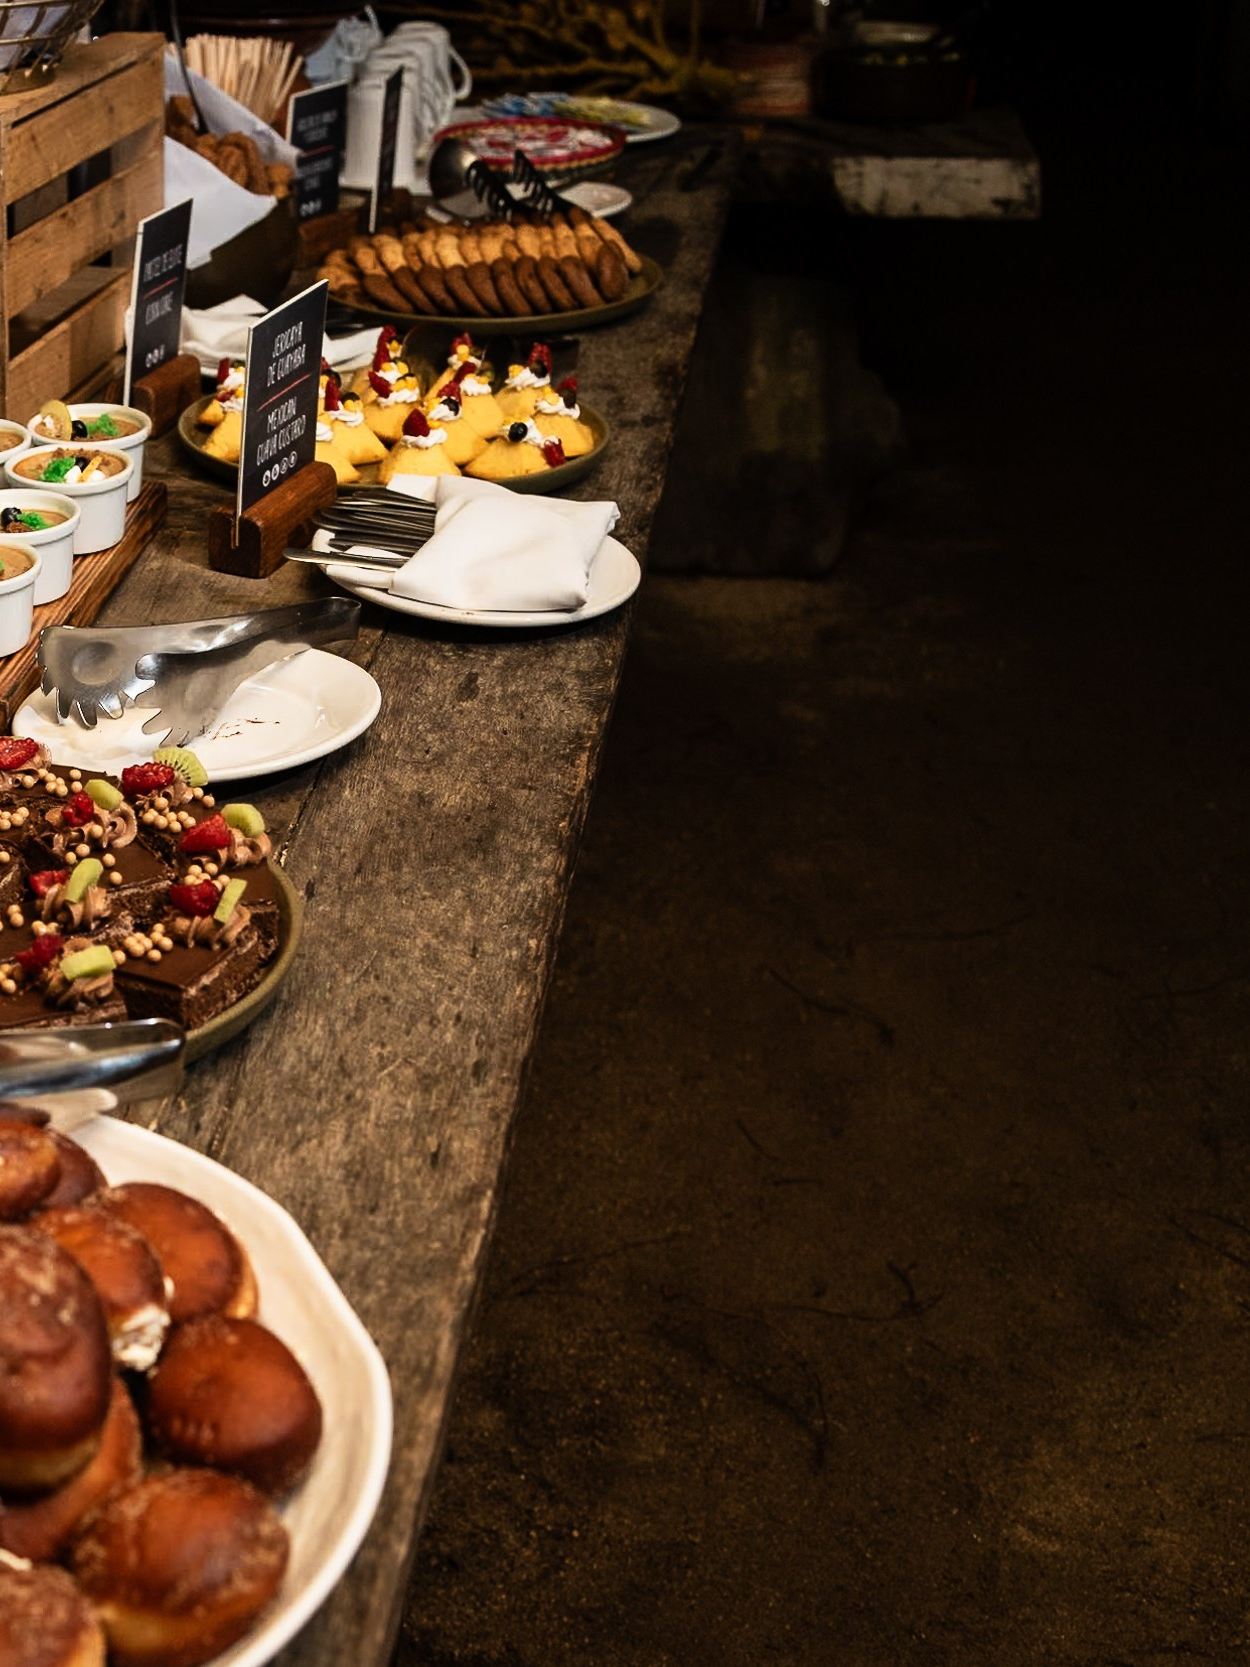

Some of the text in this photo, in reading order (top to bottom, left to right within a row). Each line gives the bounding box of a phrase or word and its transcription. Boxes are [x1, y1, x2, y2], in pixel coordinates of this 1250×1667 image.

[272, 321, 303, 358] JERICAYA
[267, 344, 306, 387] DE GUAYABA
[267, 396, 297, 433] MEXICAN
[257, 414, 306, 466] GUAVA CUSTARD
